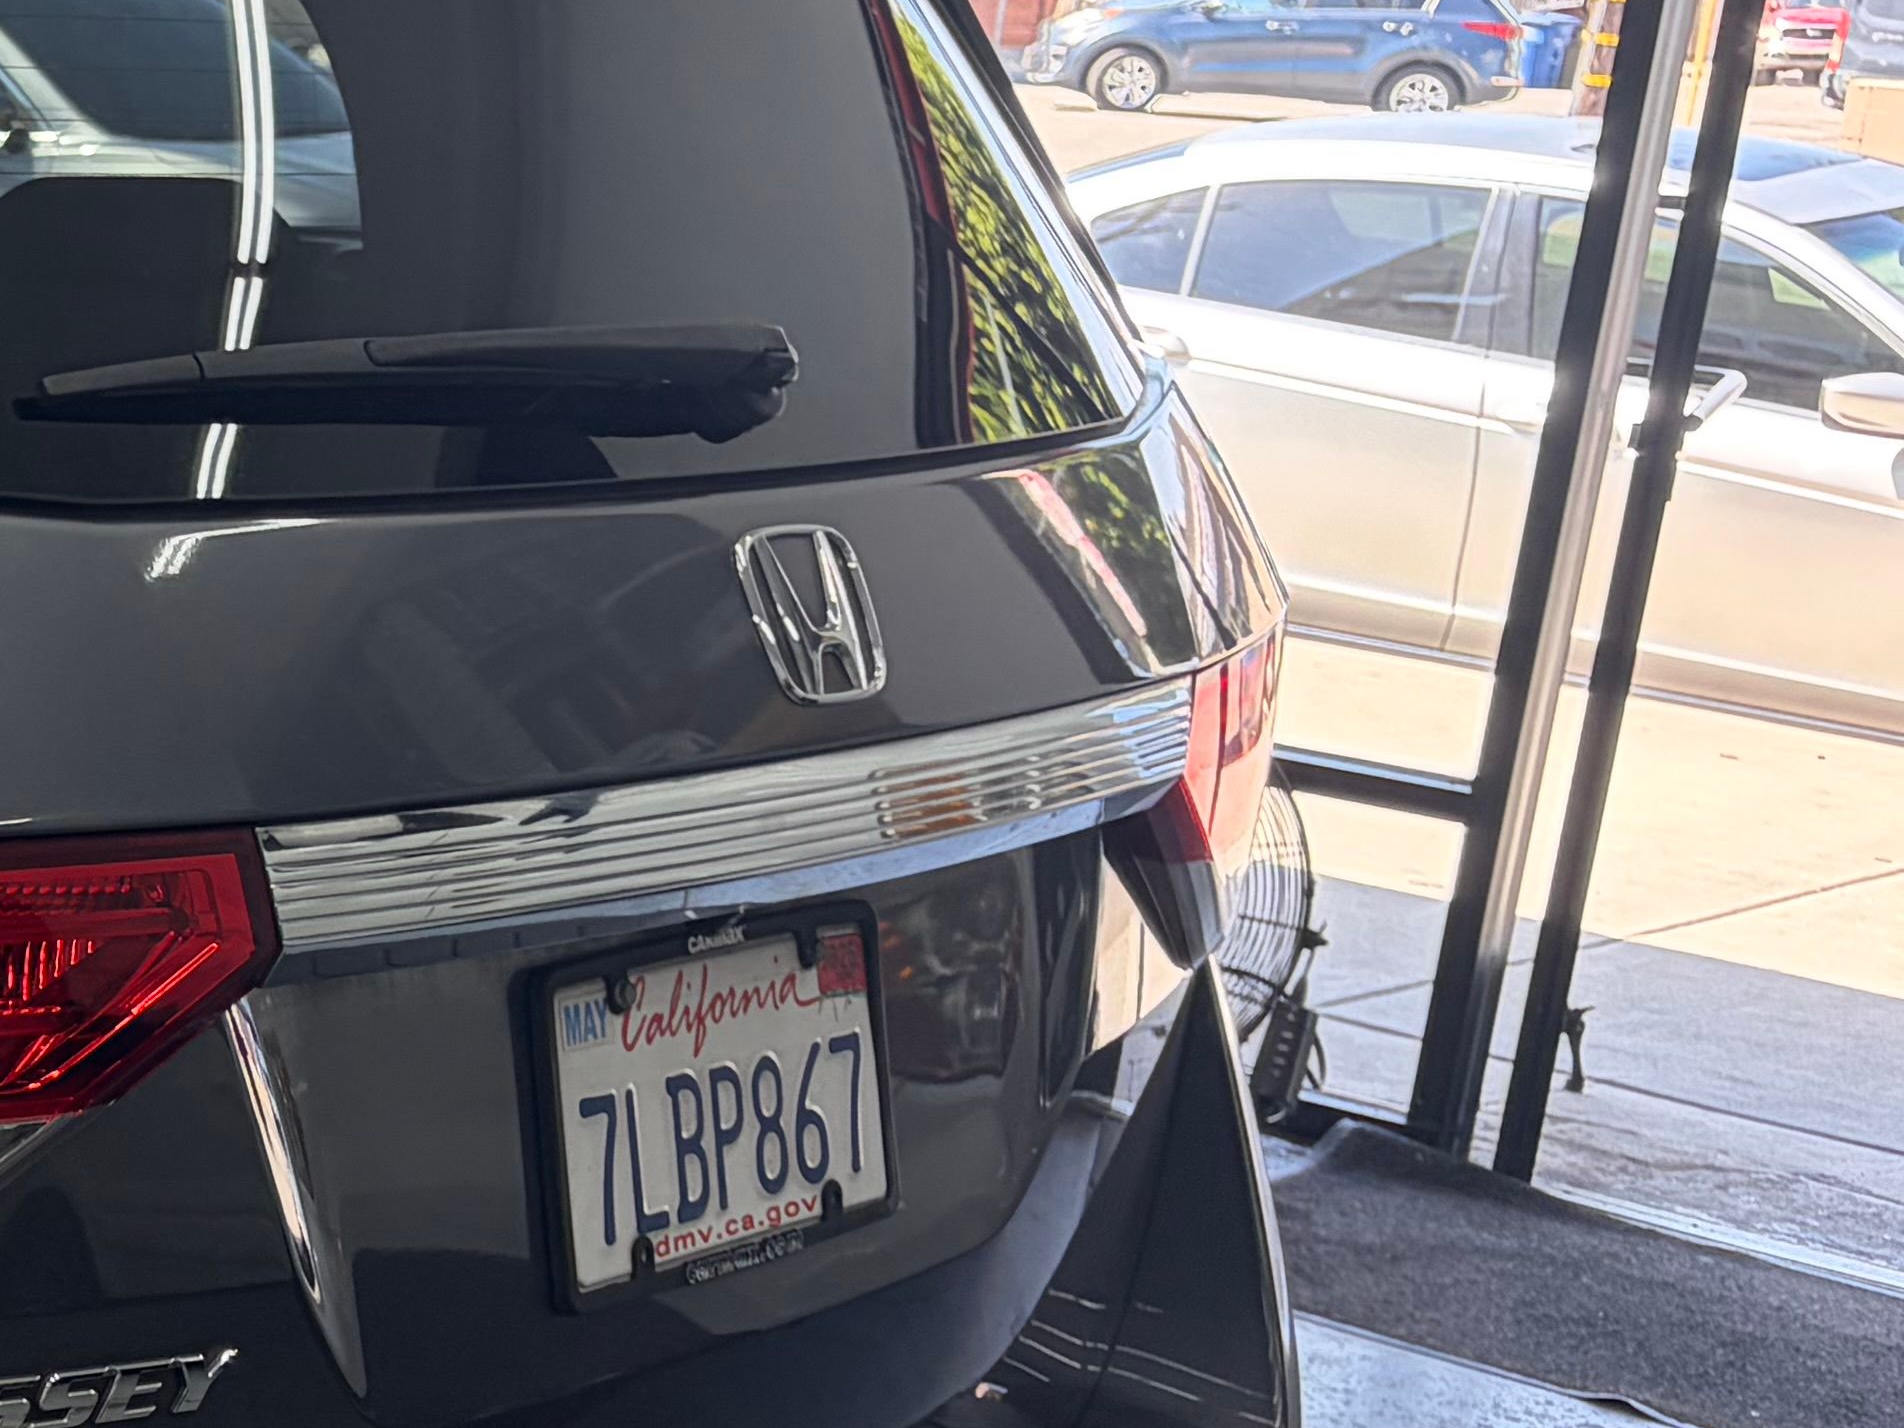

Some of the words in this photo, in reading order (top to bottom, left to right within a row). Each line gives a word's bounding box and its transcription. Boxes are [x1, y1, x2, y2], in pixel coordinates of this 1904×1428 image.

[563, 997, 608, 1047] MAY
[621, 956, 821, 1058] California
[579, 1028, 863, 1247] 7LBP867
[655, 1194, 818, 1258] dmv.ca.gov
